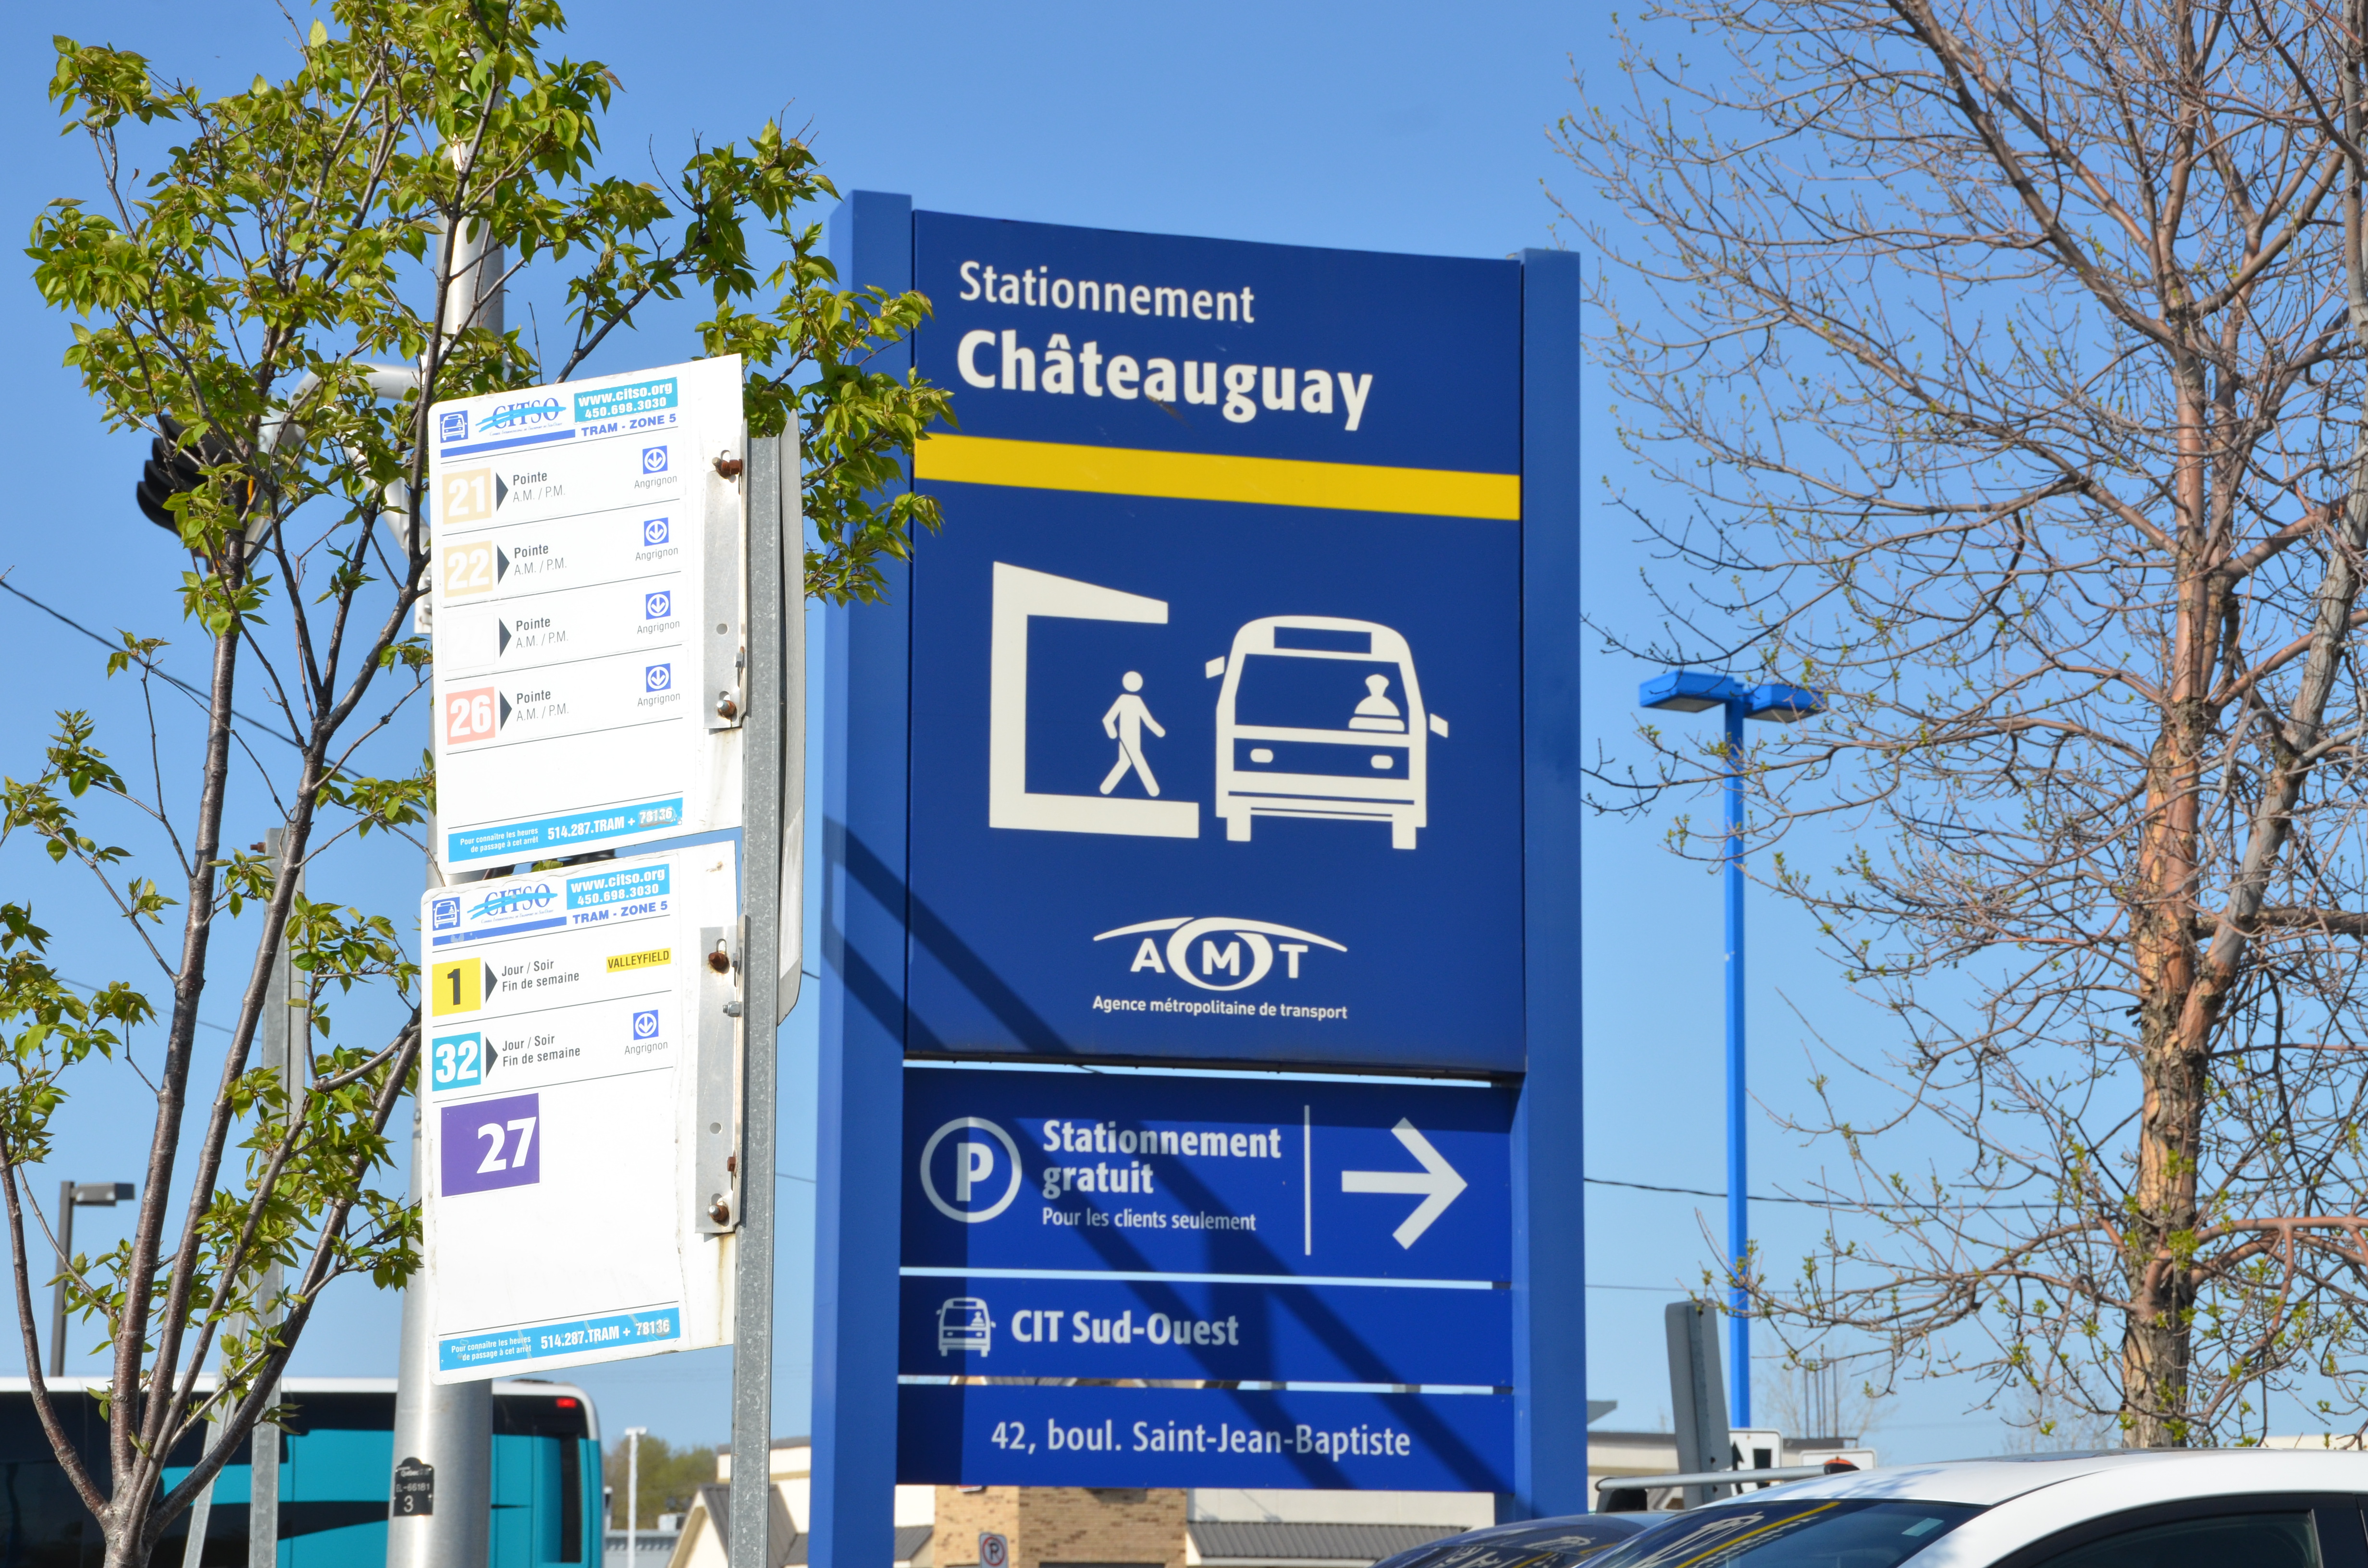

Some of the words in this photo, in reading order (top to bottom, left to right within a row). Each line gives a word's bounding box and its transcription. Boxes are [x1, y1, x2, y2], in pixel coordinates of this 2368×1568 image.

[960, 260, 1255, 323] Stationnement
[957, 329, 1372, 431] Châteauguay
[578, 383, 672, 407] www.citso.org
[493, 397, 559, 429] CITSO
[585, 397, 666, 418] 450.698.3030
[581, 422, 617, 436] TRAM
[629, 415, 665, 429] ZONE
[669, 414, 676, 422] 5
[513, 471, 547, 486] Pointe
[634, 476, 677, 489] Angrignon
[448, 476, 485, 516] 21
[513, 489, 535, 502] A.M.
[545, 484, 565, 498] P.M.
[514, 544, 548, 558] Pointe
[635, 548, 678, 561] Angrignon
[447, 549, 489, 590] 22
[514, 562, 536, 576] A.M.
[547, 557, 567, 571] P.M.
[516, 617, 550, 631] Pointe
[636, 621, 680, 635] Angrignon
[516, 635, 538, 649] A.M.
[548, 630, 568, 644] P.M.
[517, 690, 551, 704] Pointe
[637, 693, 680, 707] Angrignon
[450, 695, 492, 737] 26
[517, 708, 538, 722] A.M.
[549, 703, 569, 716] P.M.
[548, 816, 624, 840] 514.287.TRAM
[640, 807, 672, 823] 78136
[476, 833, 505, 843] connaître
[517, 828, 538, 836] heures
[480, 841, 505, 853] passage
[523, 836, 538, 845] arrêt
[571, 869, 665, 893] www.citso.org
[484, 883, 550, 916] CITSO
[577, 883, 659, 905] 450.698.3030
[572, 910, 609, 924] TRAM
[621, 902, 656, 917] ZONE
[660, 901, 667, 910] 5
[502, 966, 524, 976] Jour
[533, 959, 554, 971] Soir
[608, 950, 669, 968] VALLEYFIELD
[447, 968, 460, 1005] 1
[502, 980, 517, 992] Fin
[521, 979, 533, 989] de
[536, 972, 580, 986] semaine
[1093, 995, 1146, 1013] Agence
[1150, 997, 1256, 1016] métropolitaine
[1259, 1002, 1276, 1016] de
[1280, 1004, 1347, 1021] transport
[502, 1041, 524, 1051] Jour
[534, 1034, 555, 1046] Soir
[625, 1041, 667, 1055] Angrignon
[435, 1040, 478, 1083] 32
[503, 1055, 518, 1067] Fin
[522, 1054, 533, 1064] de
[537, 1047, 580, 1062] semaine
[476, 1116, 537, 1174] 27
[1043, 1119, 1281, 1158] Stationnement
[956, 1142, 994, 1202] P
[1043, 1161, 1153, 1200] gratuit
[1043, 1208, 1081, 1225] Pour
[1086, 1208, 1109, 1227] les
[1114, 1208, 1166, 1229] clients
[1171, 1211, 1256, 1231] seulement
[541, 1325, 619, 1349] 514.287.TRAM
[635, 1319, 669, 1335] 78136
[1011, 1310, 1063, 1343] CIT
[1073, 1310, 1239, 1346] Sud-Ouest
[468, 1341, 496, 1351] connaître
[509, 1336, 531, 1345] heures
[472, 1350, 497, 1361] passage
[516, 1345, 531, 1353] arrêt
[991, 1421, 1036, 1455] 42,
[1048, 1419, 1121, 1451] boul.
[1133, 1420, 1410, 1461] Saint-Jean-Baptiste
[404, 1495, 414, 1513] 3
